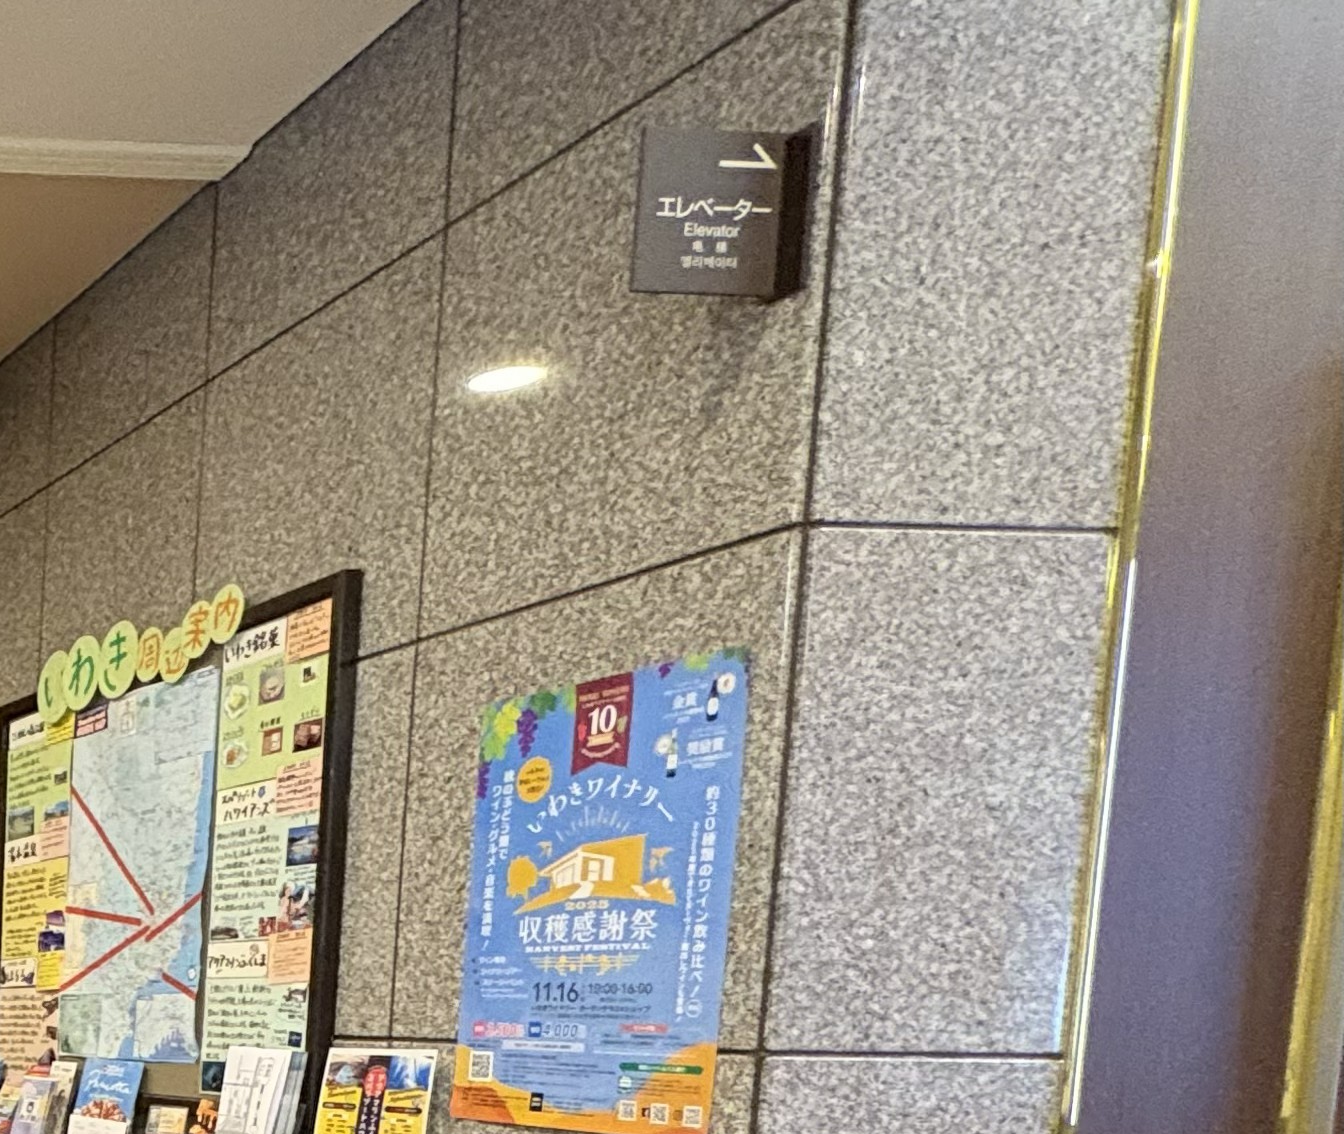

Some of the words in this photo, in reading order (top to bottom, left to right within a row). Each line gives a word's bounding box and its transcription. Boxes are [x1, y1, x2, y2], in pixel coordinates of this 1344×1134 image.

[655, 196, 773, 221] エレベーター
[683, 221, 741, 238] Elevator
[588, 704, 618, 735] 10
[526, 774, 675, 834] いわきワイナリー
[518, 908, 658, 944] 収穫感謝祭
[532, 981, 579, 1003] 11.16
